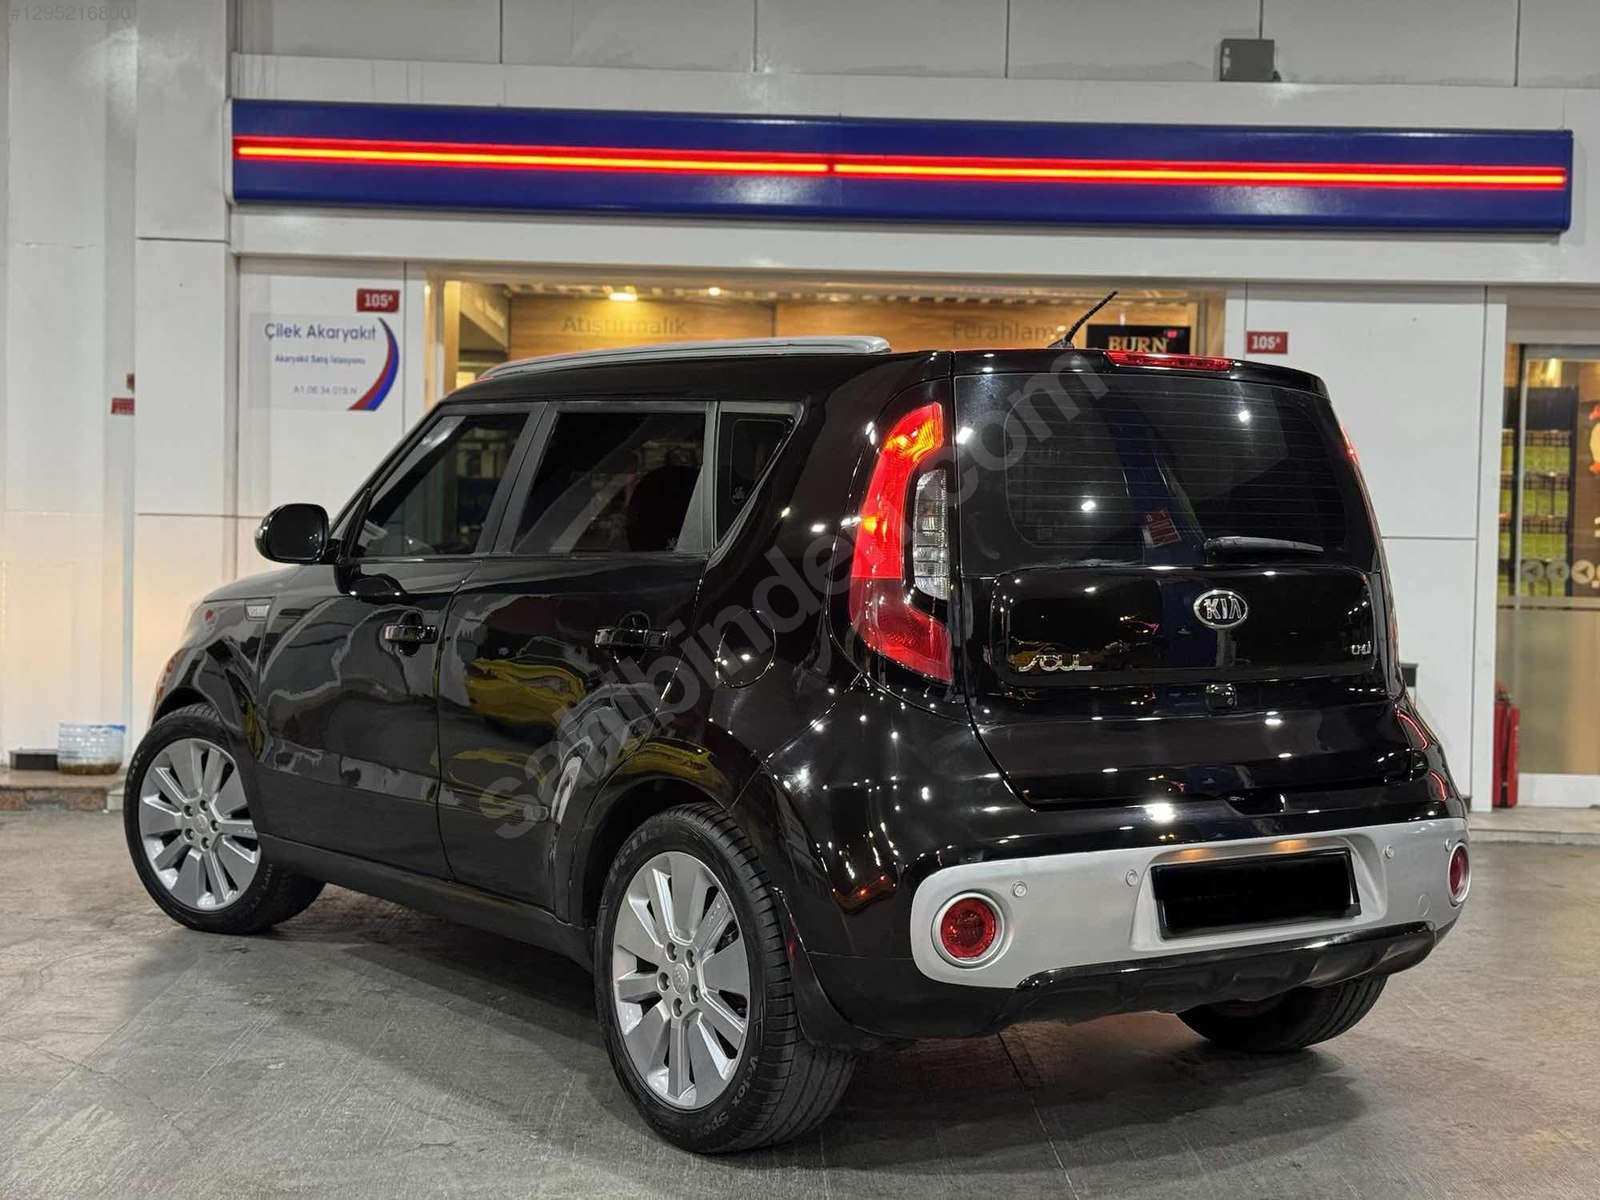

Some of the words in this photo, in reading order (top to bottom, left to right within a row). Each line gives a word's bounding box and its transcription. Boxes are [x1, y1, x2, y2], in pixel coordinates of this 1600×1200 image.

[264, 322, 302, 341] Çilek
[306, 324, 376, 343] Akaryakıt
[952, 319, 1067, 341] Ferahlam
[1108, 336, 1169, 353] BURN
[1206, 597, 1243, 620] KIA
